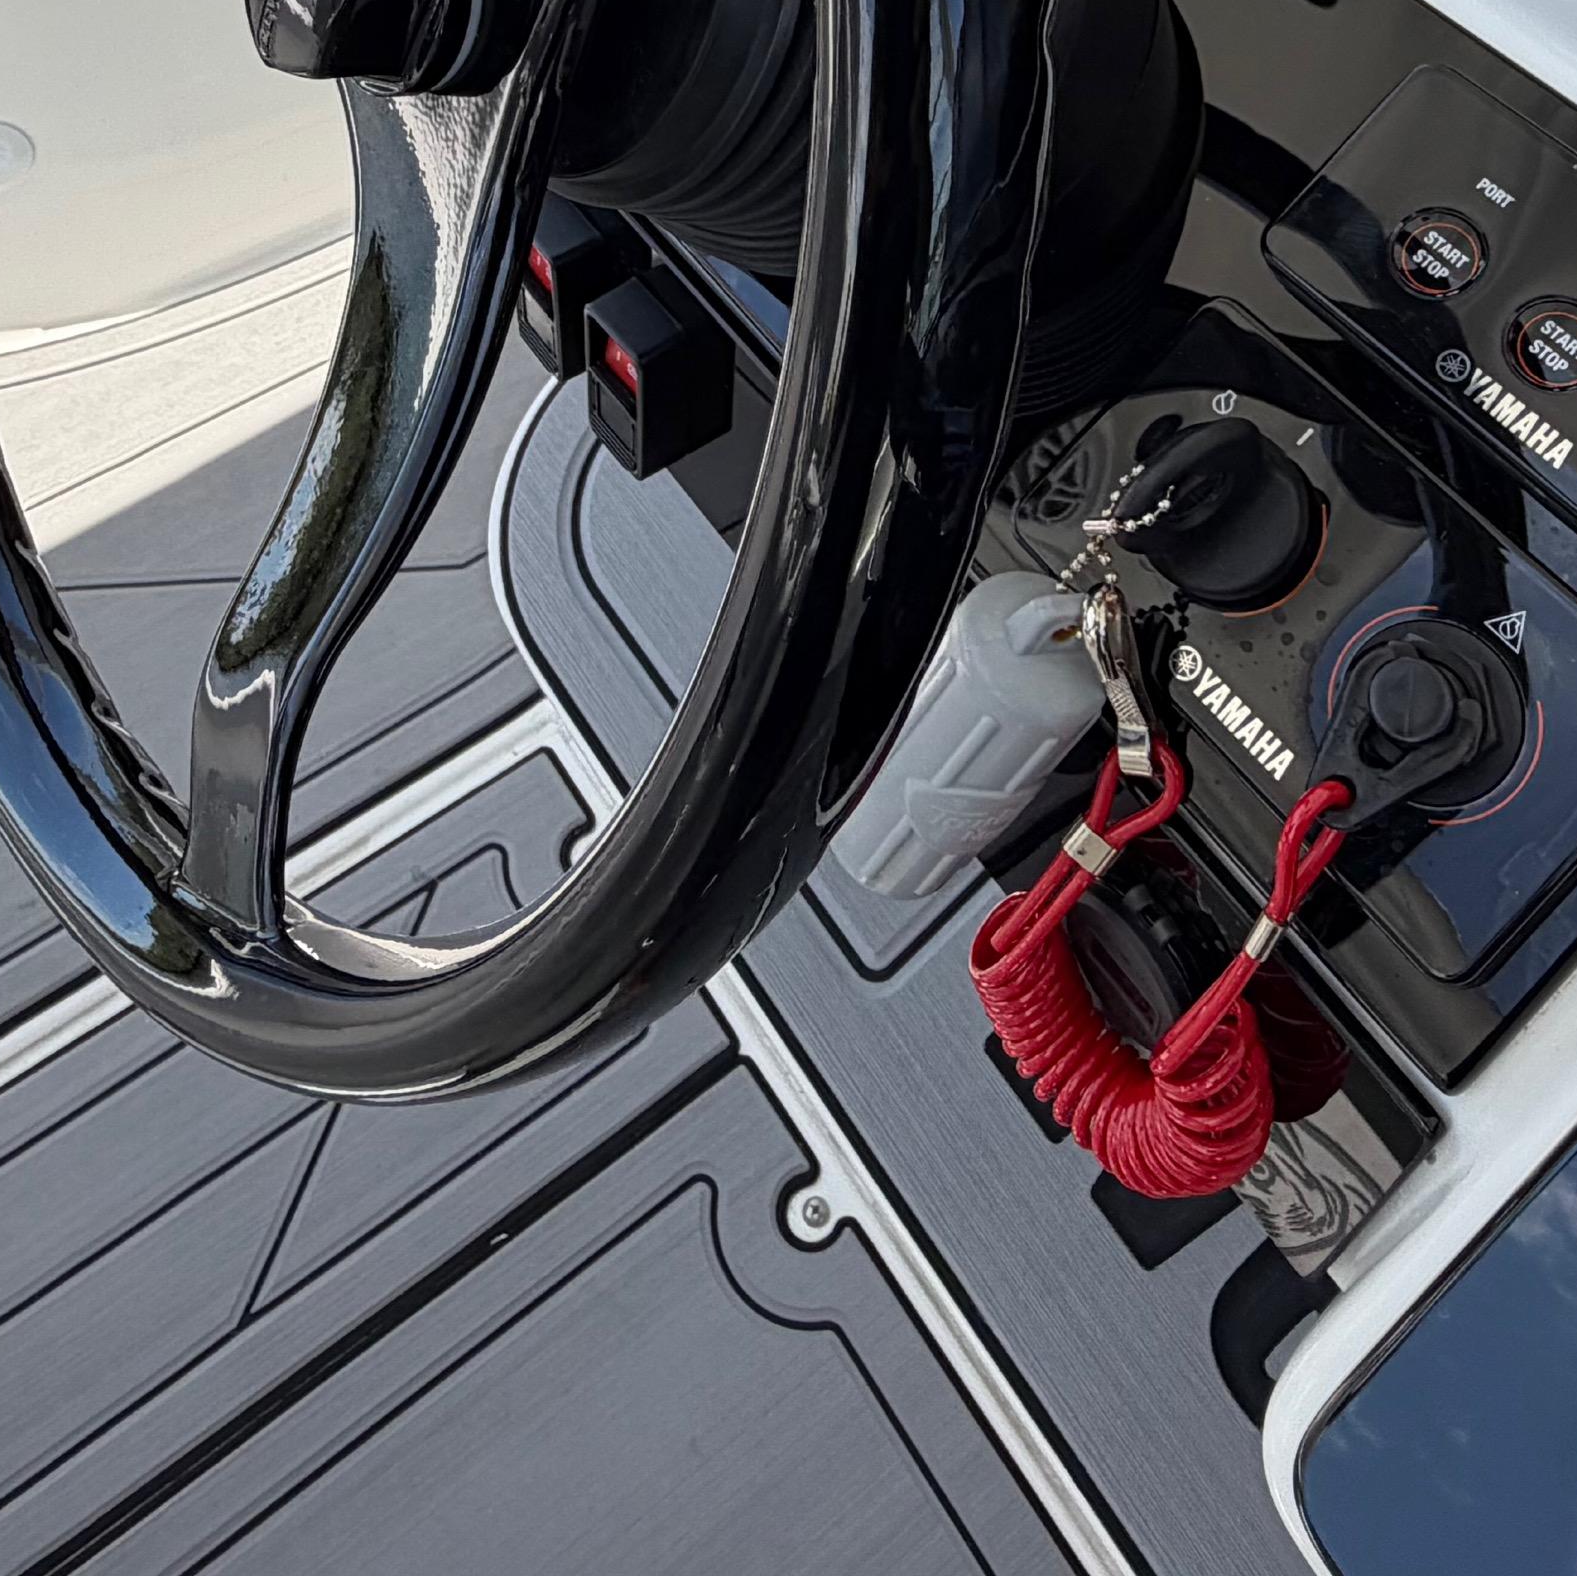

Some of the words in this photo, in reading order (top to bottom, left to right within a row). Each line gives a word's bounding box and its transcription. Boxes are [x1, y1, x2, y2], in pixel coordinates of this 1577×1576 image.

[1475, 177, 1516, 209] PORT
[1412, 247, 1450, 281] STOP
[1423, 230, 1470, 270] START
[1528, 338, 1570, 374] STOP
[1463, 368, 1574, 471] YAMAHA
[1193, 667, 1295, 781] YAMAHA
